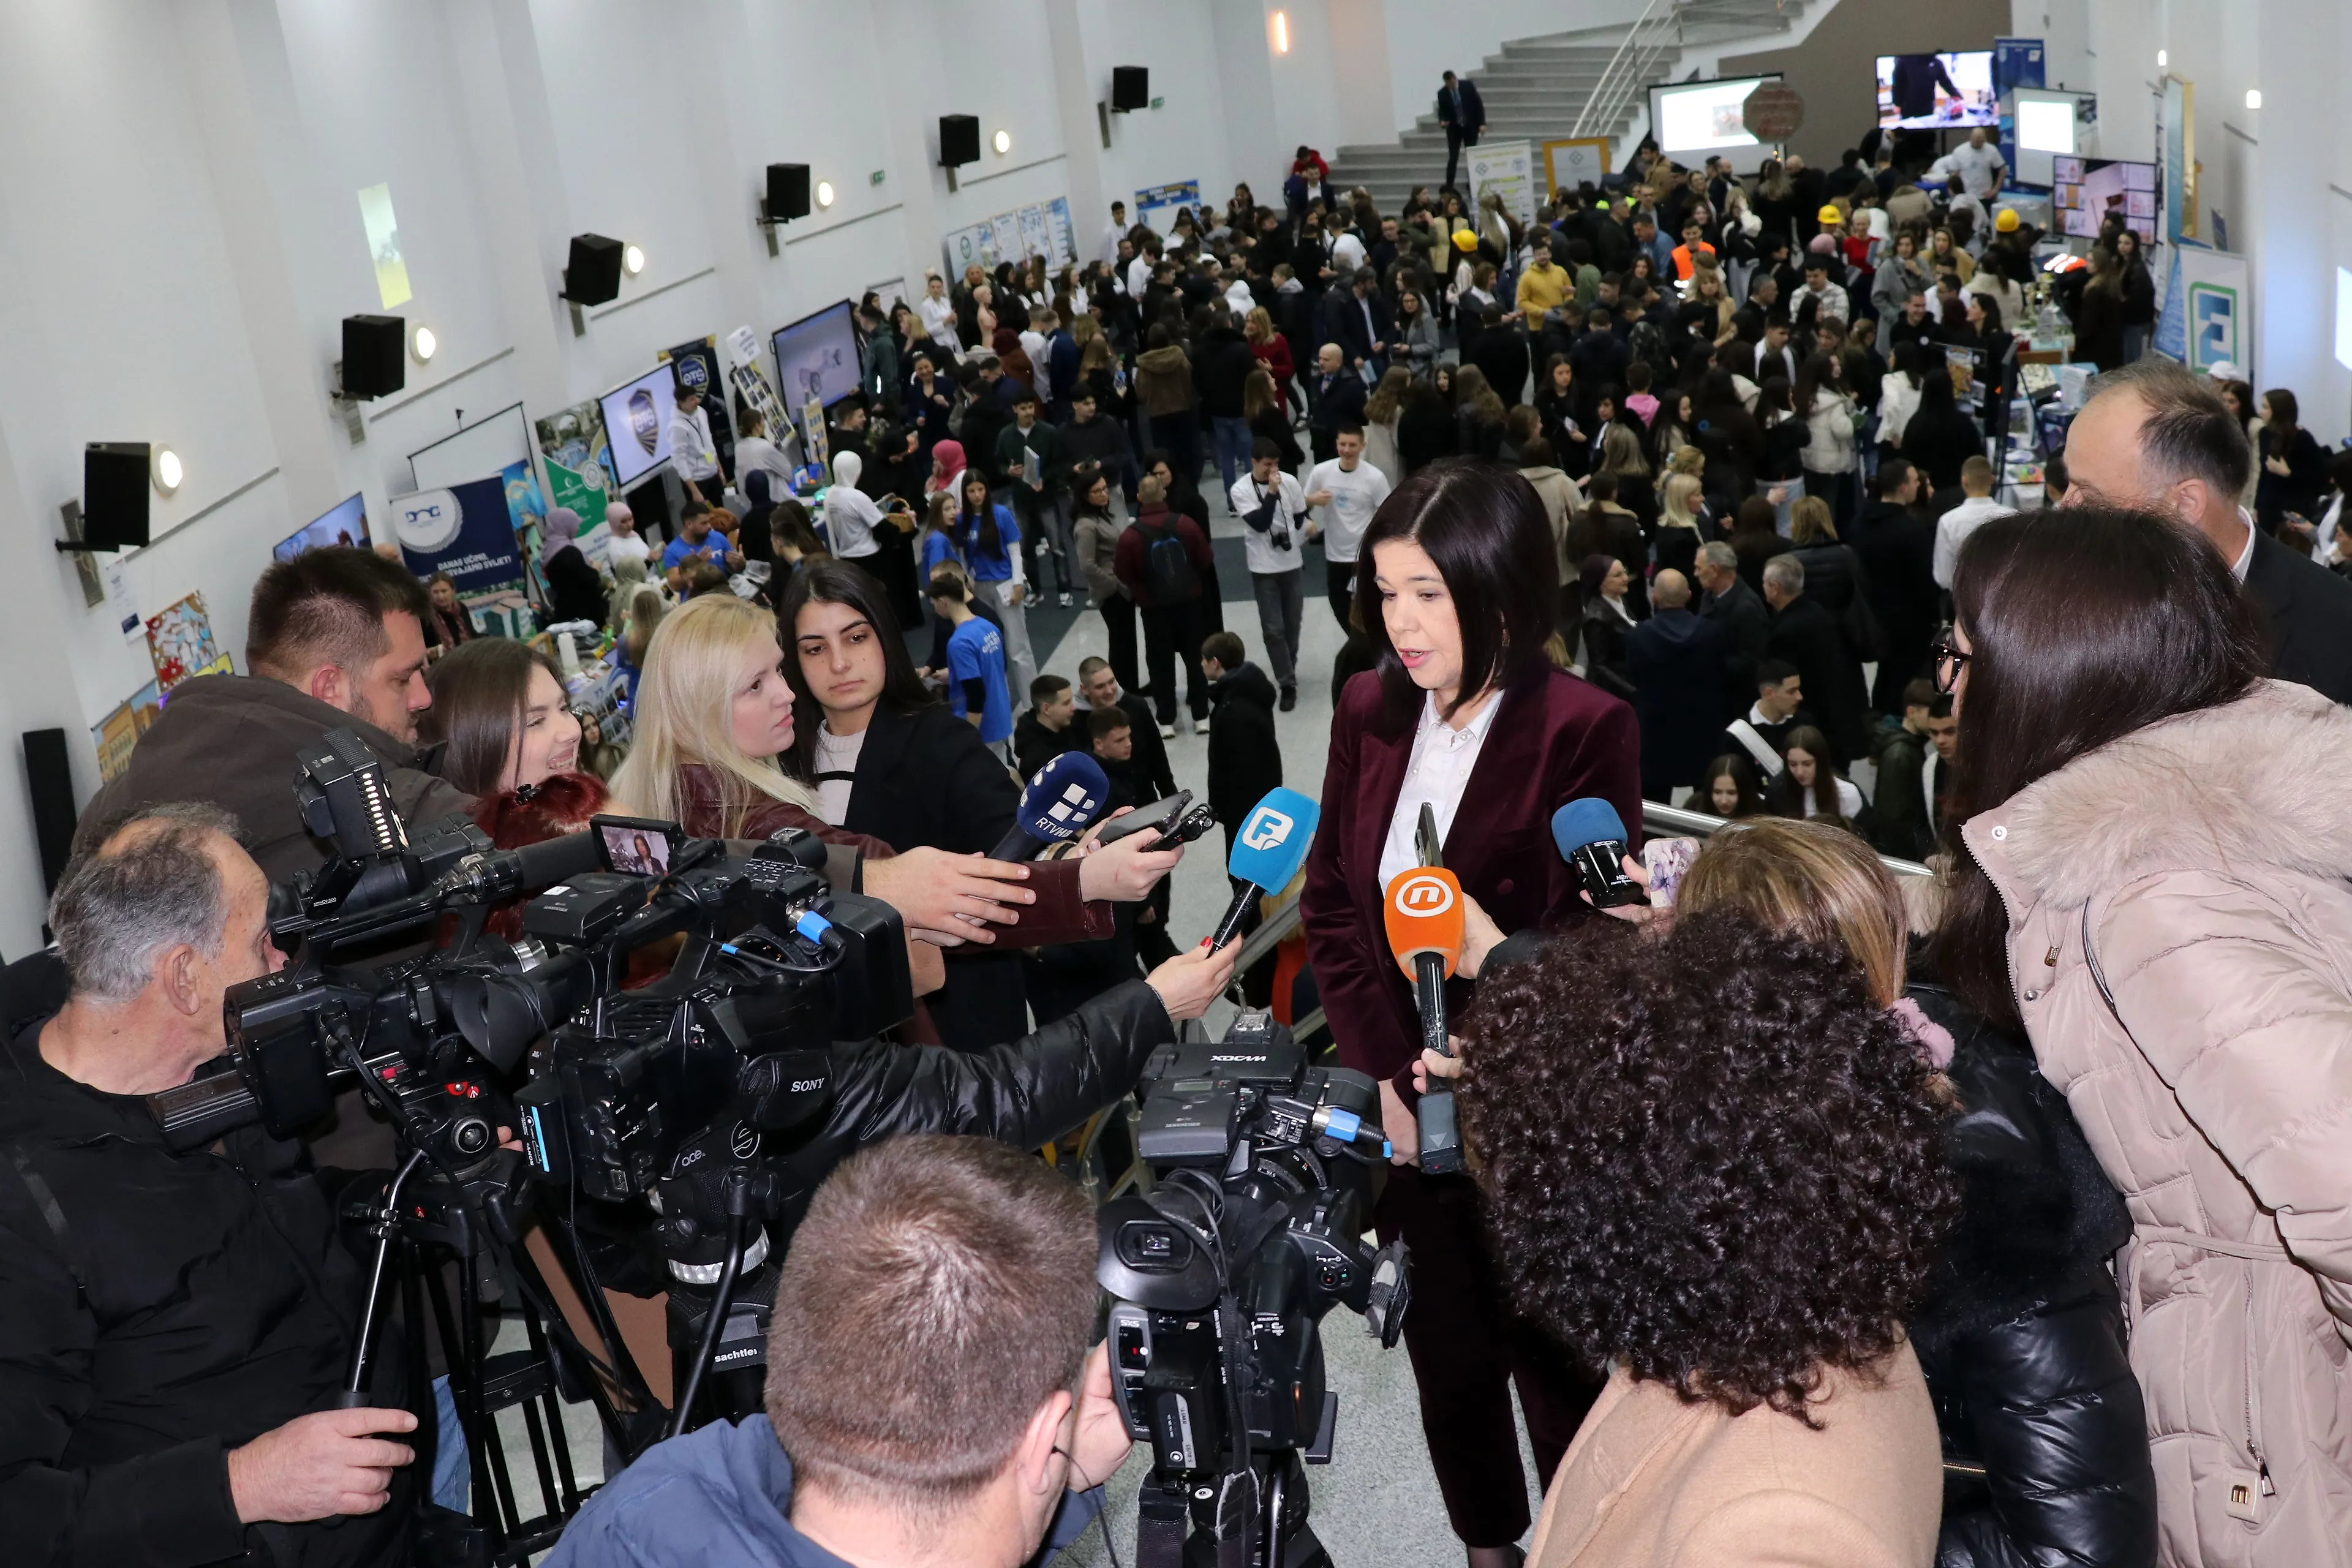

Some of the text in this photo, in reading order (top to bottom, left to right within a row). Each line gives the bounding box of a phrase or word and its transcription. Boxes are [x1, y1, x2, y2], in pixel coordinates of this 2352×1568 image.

[1035, 816, 1074, 838] RTVHB
[1252, 813, 1283, 840] F
[791, 1077, 825, 1092] SONY
[682, 1150, 702, 1167] ace
